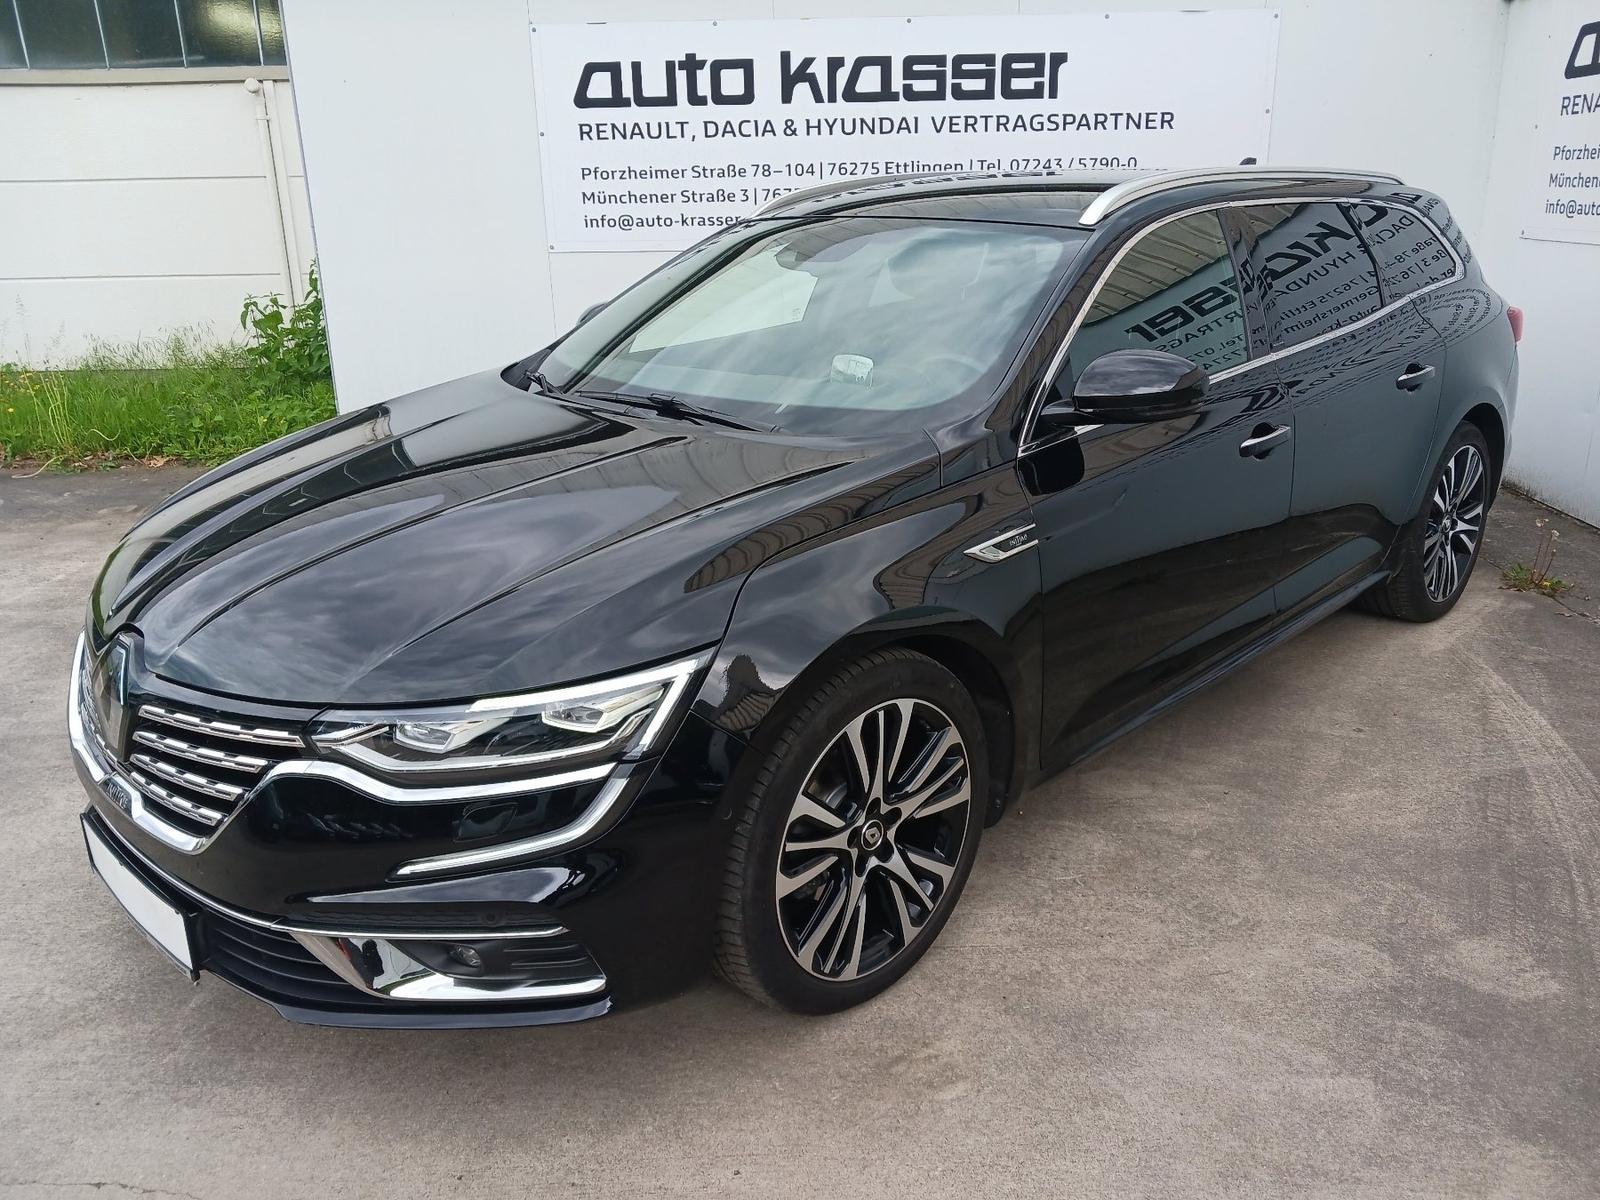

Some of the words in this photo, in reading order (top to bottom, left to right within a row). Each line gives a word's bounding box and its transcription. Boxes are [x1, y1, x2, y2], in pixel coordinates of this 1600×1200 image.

[573, 53, 755, 109] auto
[780, 50, 1068, 104] krasser
[578, 120, 696, 142] RENAULT,
[703, 118, 777, 139] DACIA
[782, 118, 798, 137] &
[805, 116, 919, 137] HYUNDAI
[930, 111, 1175, 133] VERTRAGSPARTNER
[581, 166, 687, 181] Pforzheimer
[691, 164, 747, 179] Straße
[827, 162, 880, 176] 76275
[884, 160, 964, 175] Ettlingen
[1010, 158, 1062, 171] 07243
[581, 190, 676, 205] Münchener
[680, 189, 736, 203] Straße
[740, 189, 749, 202] 3
